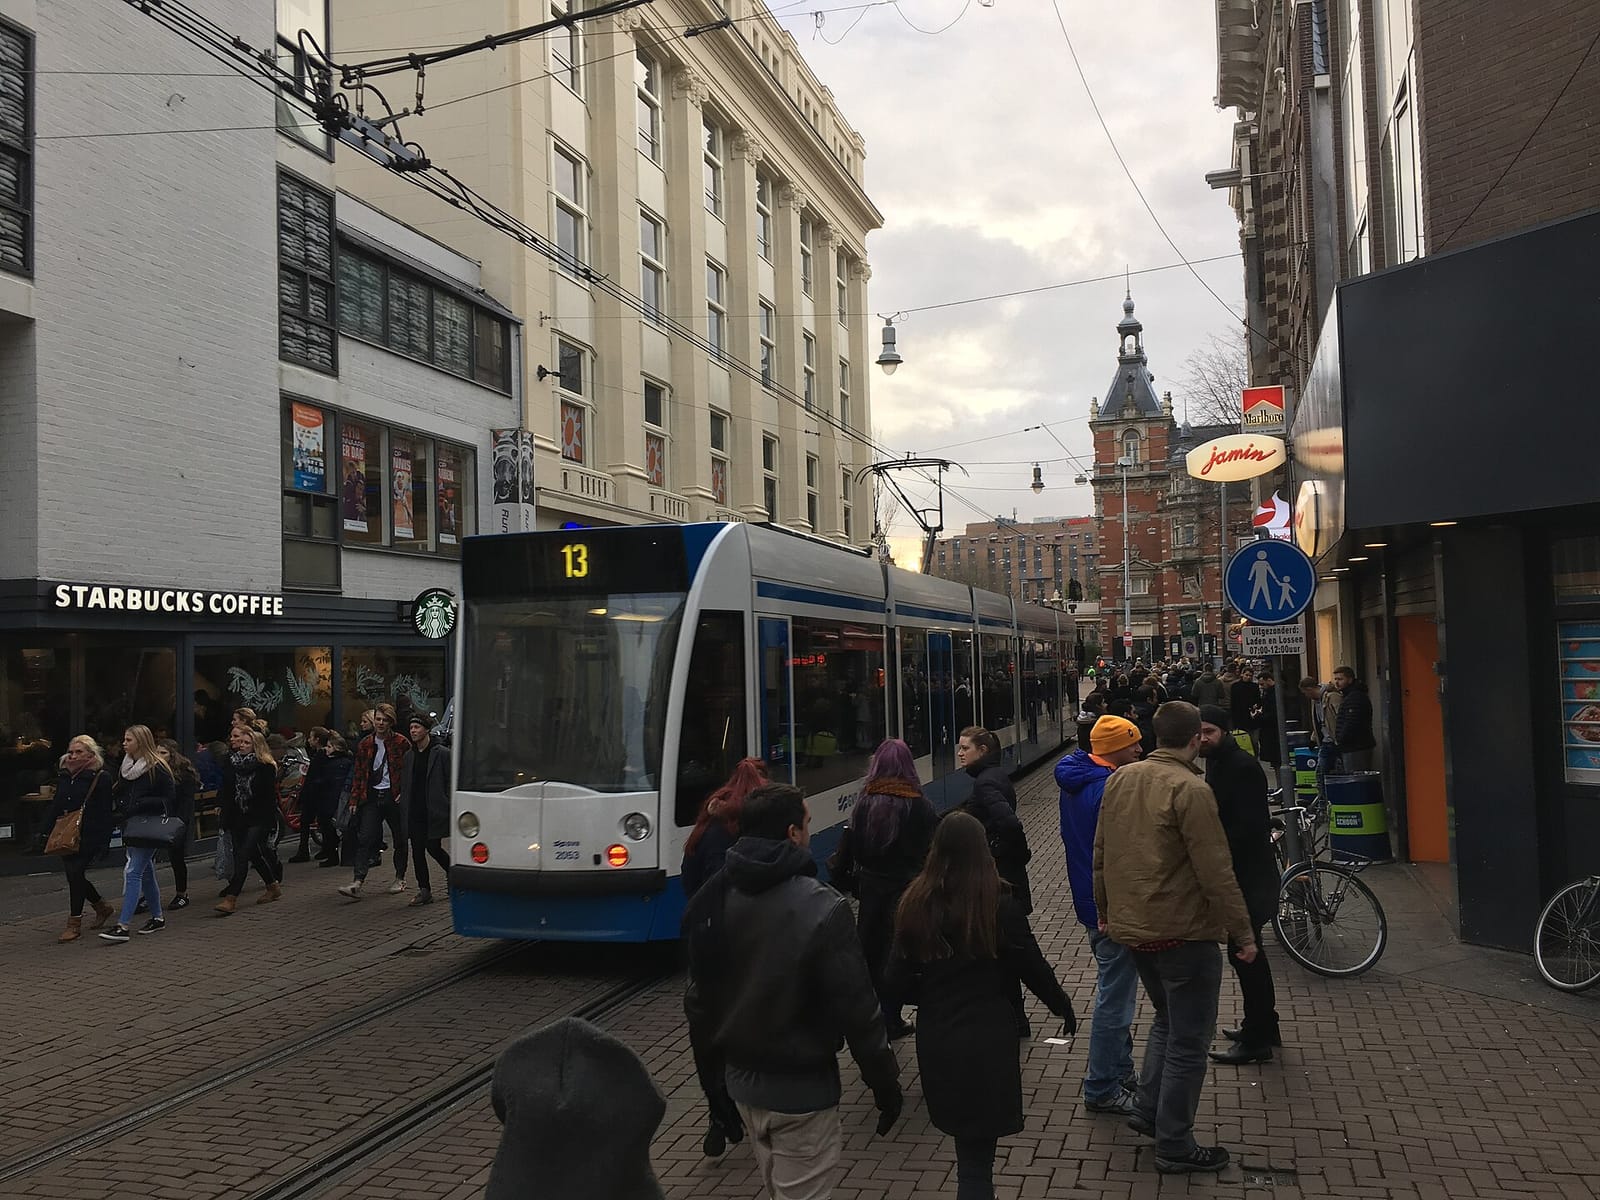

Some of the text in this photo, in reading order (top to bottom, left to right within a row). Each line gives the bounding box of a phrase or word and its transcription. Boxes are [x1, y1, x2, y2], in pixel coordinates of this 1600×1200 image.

[1243, 409, 1284, 425] Marlboro
[1200, 443, 1277, 476] jamin
[560, 543, 589, 578] 13
[55, 584, 283, 616] STARBUCKS COFFEE
[1246, 636, 1267, 646] Laden
[1278, 635, 1303, 644] Lossen
[1250, 625, 1300, 637] Uitgezonderd:
